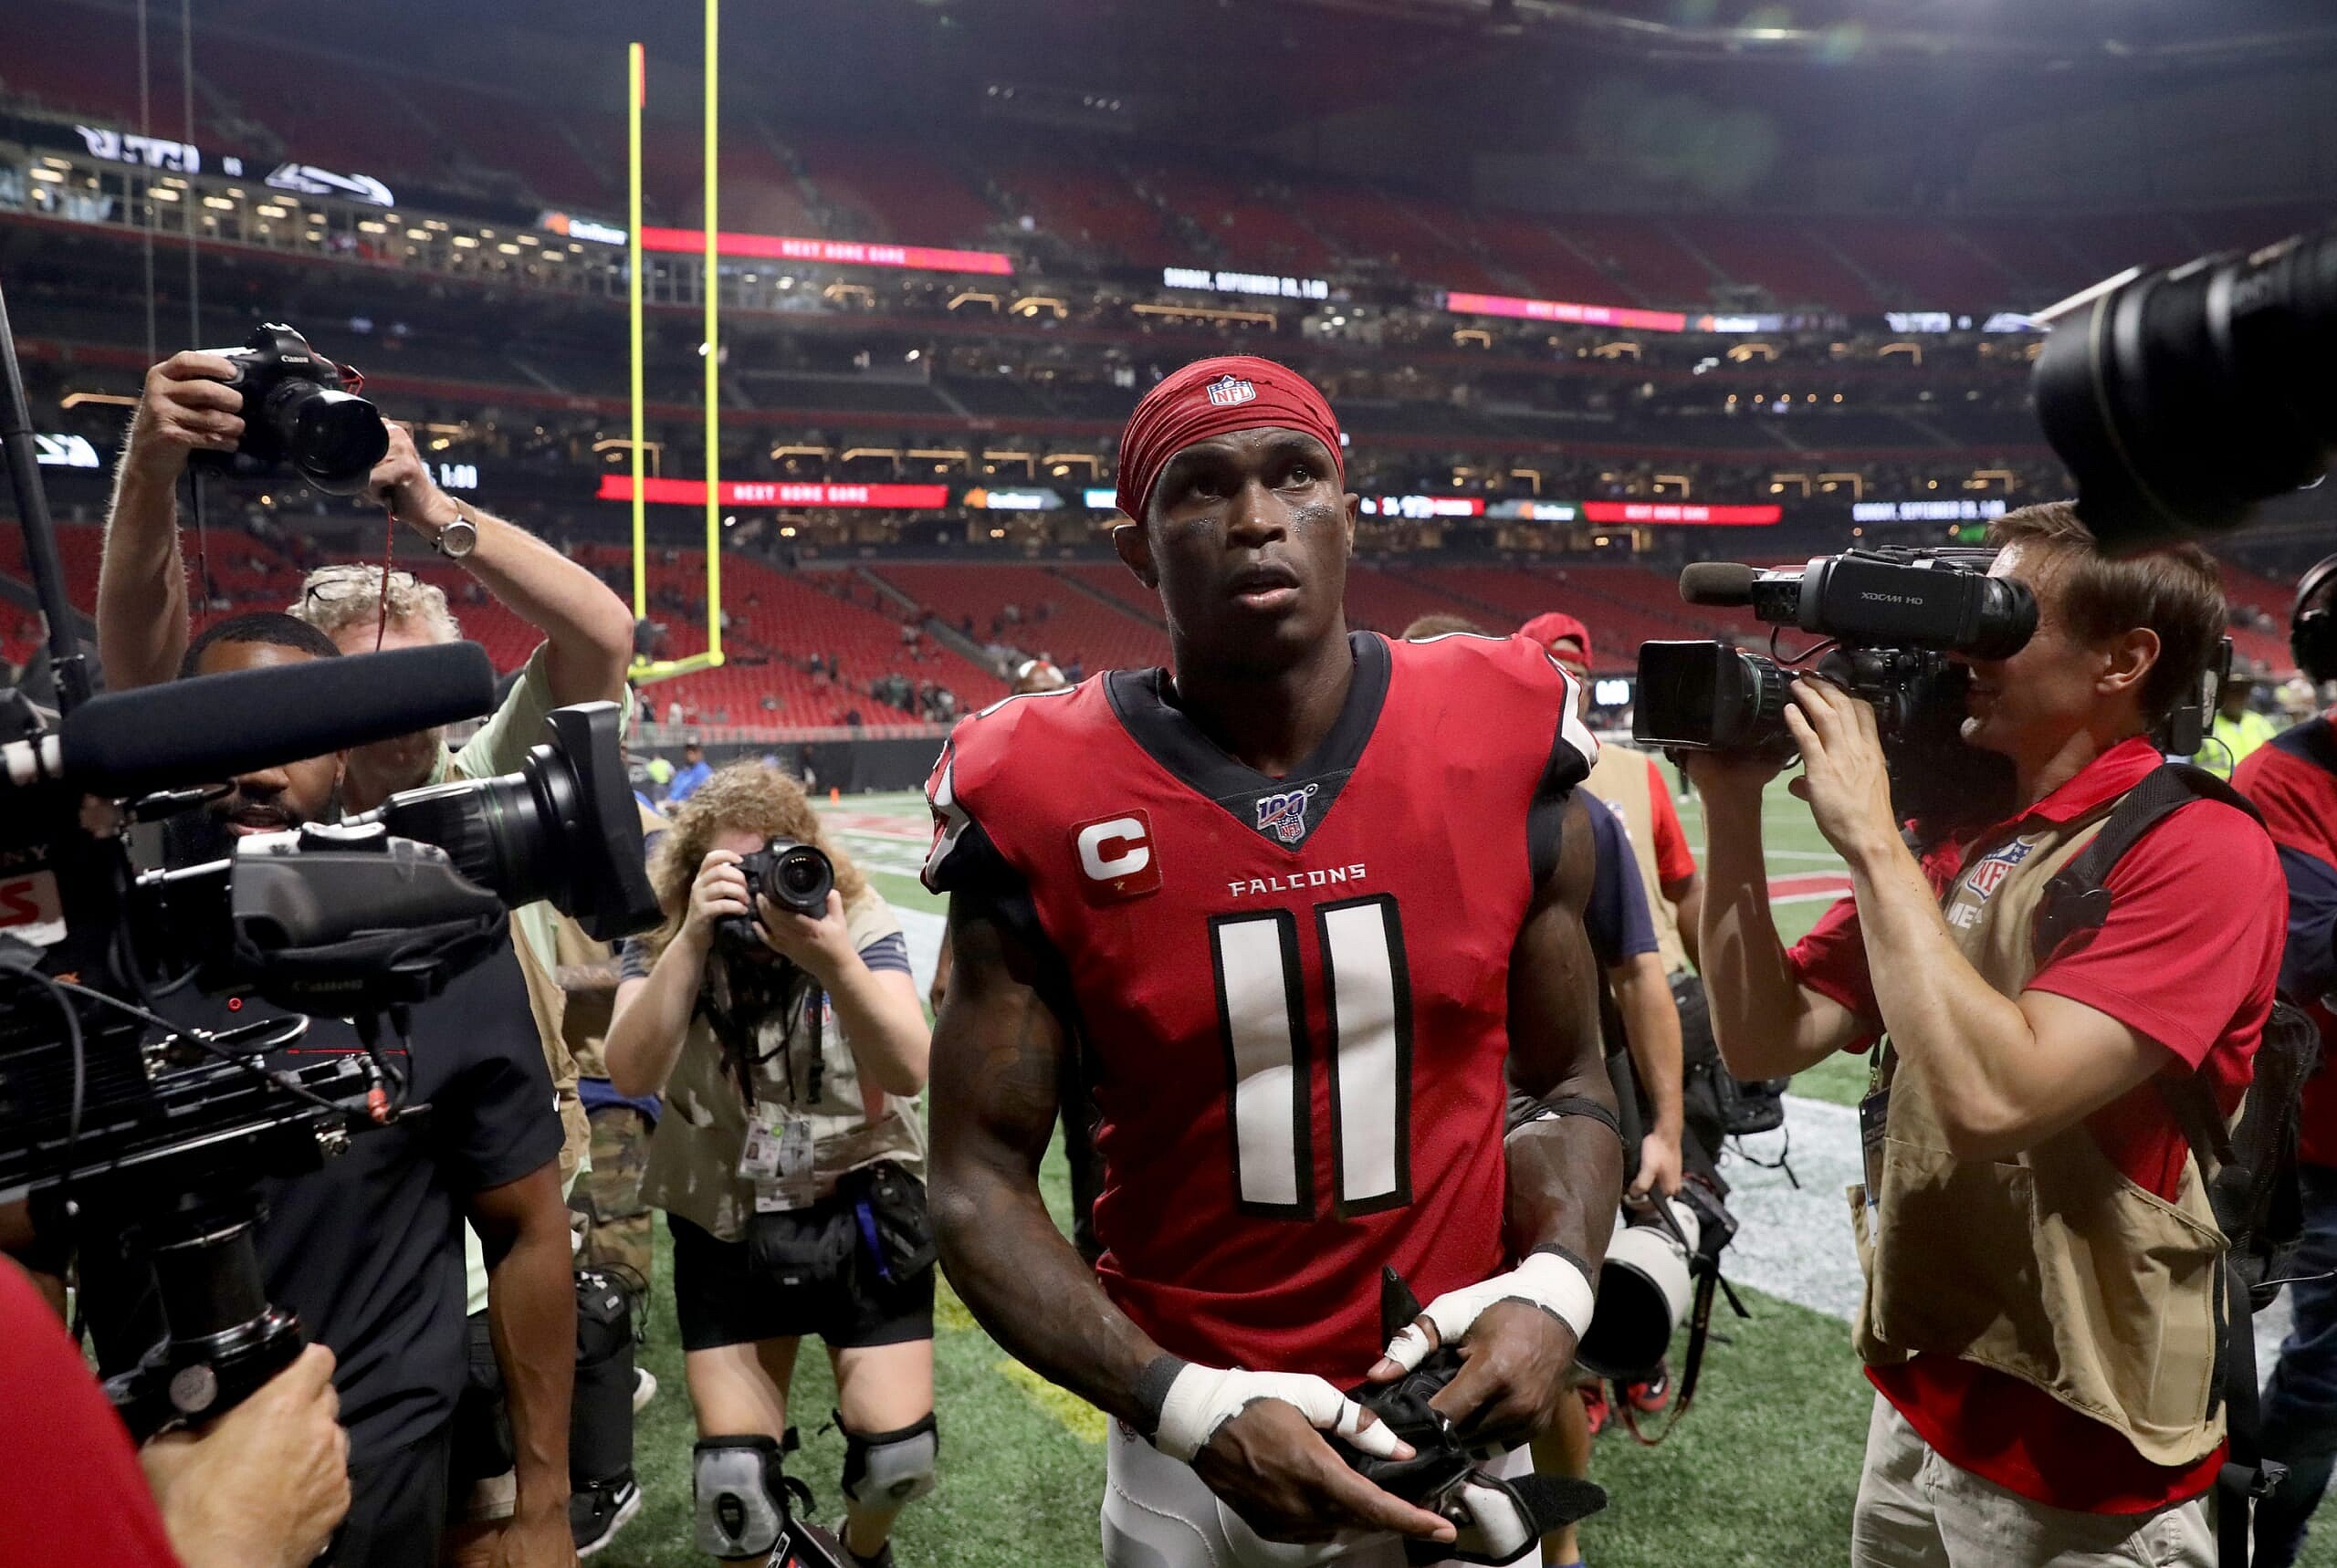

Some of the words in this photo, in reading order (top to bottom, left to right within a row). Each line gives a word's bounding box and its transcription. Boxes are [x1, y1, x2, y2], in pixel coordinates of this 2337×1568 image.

[280, 354, 309, 363] Canon
[1215, 387, 1251, 402] NFL
[1861, 591, 1902, 603] XDCAM
[1905, 596, 1923, 605] HD
[1280, 822, 1303, 839] NFL
[1077, 817, 1150, 881] C
[1228, 863, 1367, 897] FALCONS
[1209, 893, 1414, 1221] 11
